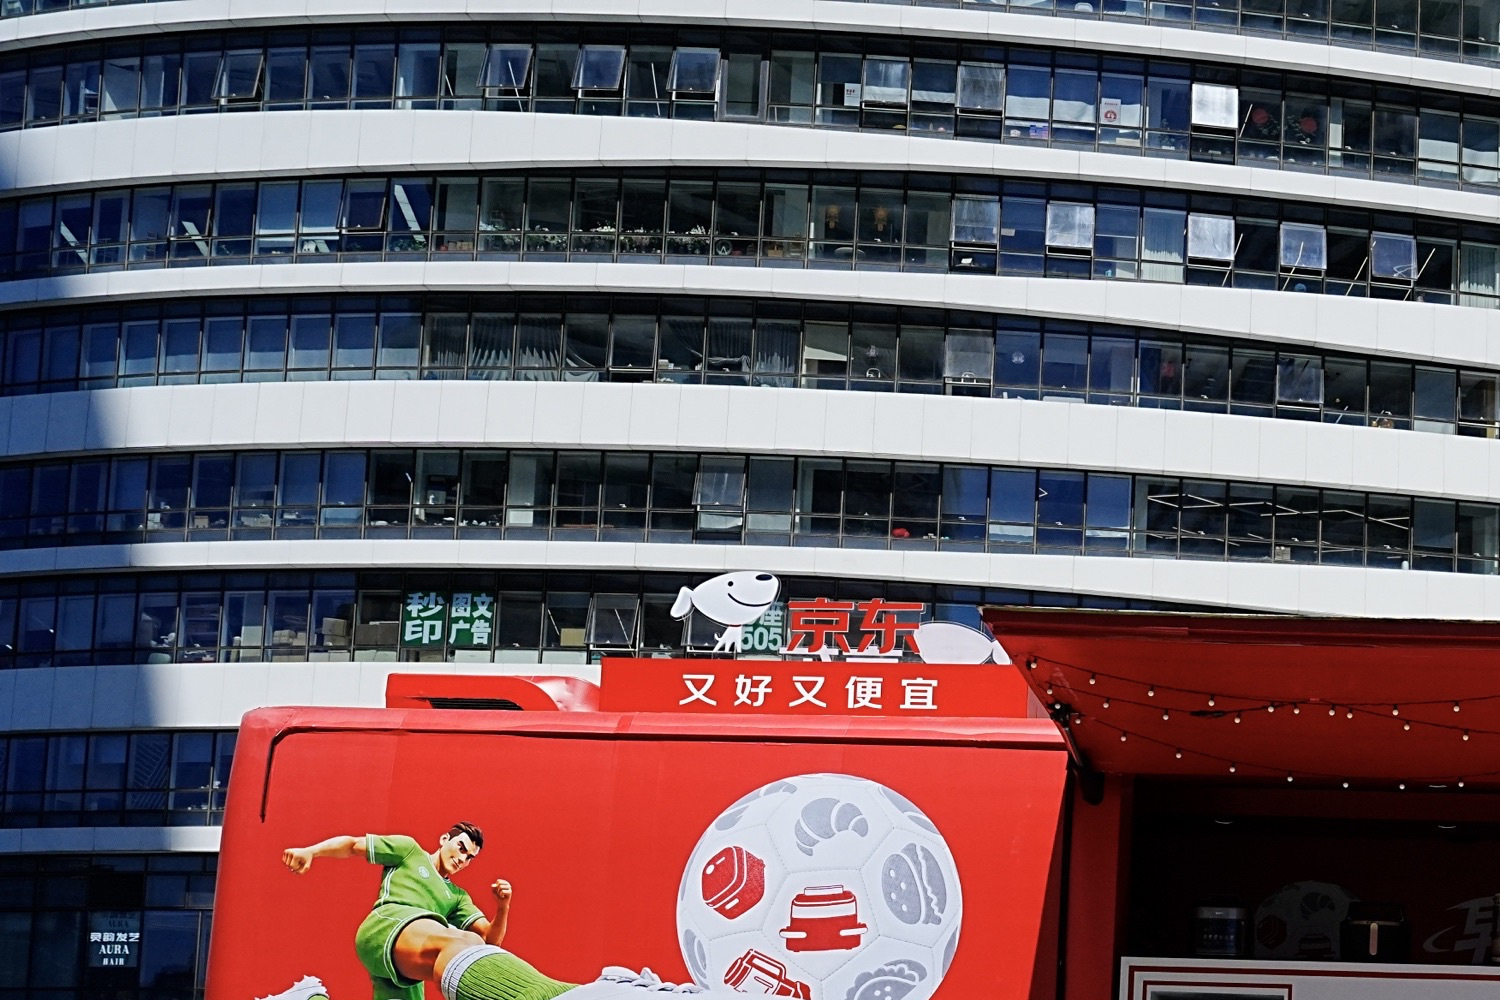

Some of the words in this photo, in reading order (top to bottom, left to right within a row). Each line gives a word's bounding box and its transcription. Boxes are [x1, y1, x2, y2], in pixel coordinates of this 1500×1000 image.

[450, 593, 493, 617] 图文
[449, 620, 492, 645] 广告
[787, 597, 926, 654] 京东
[741, 628, 783, 651] 505
[682, 673, 938, 710] 又好又便宜
[99, 944, 130, 955] AURA
[102, 957, 125, 966] HAIR
